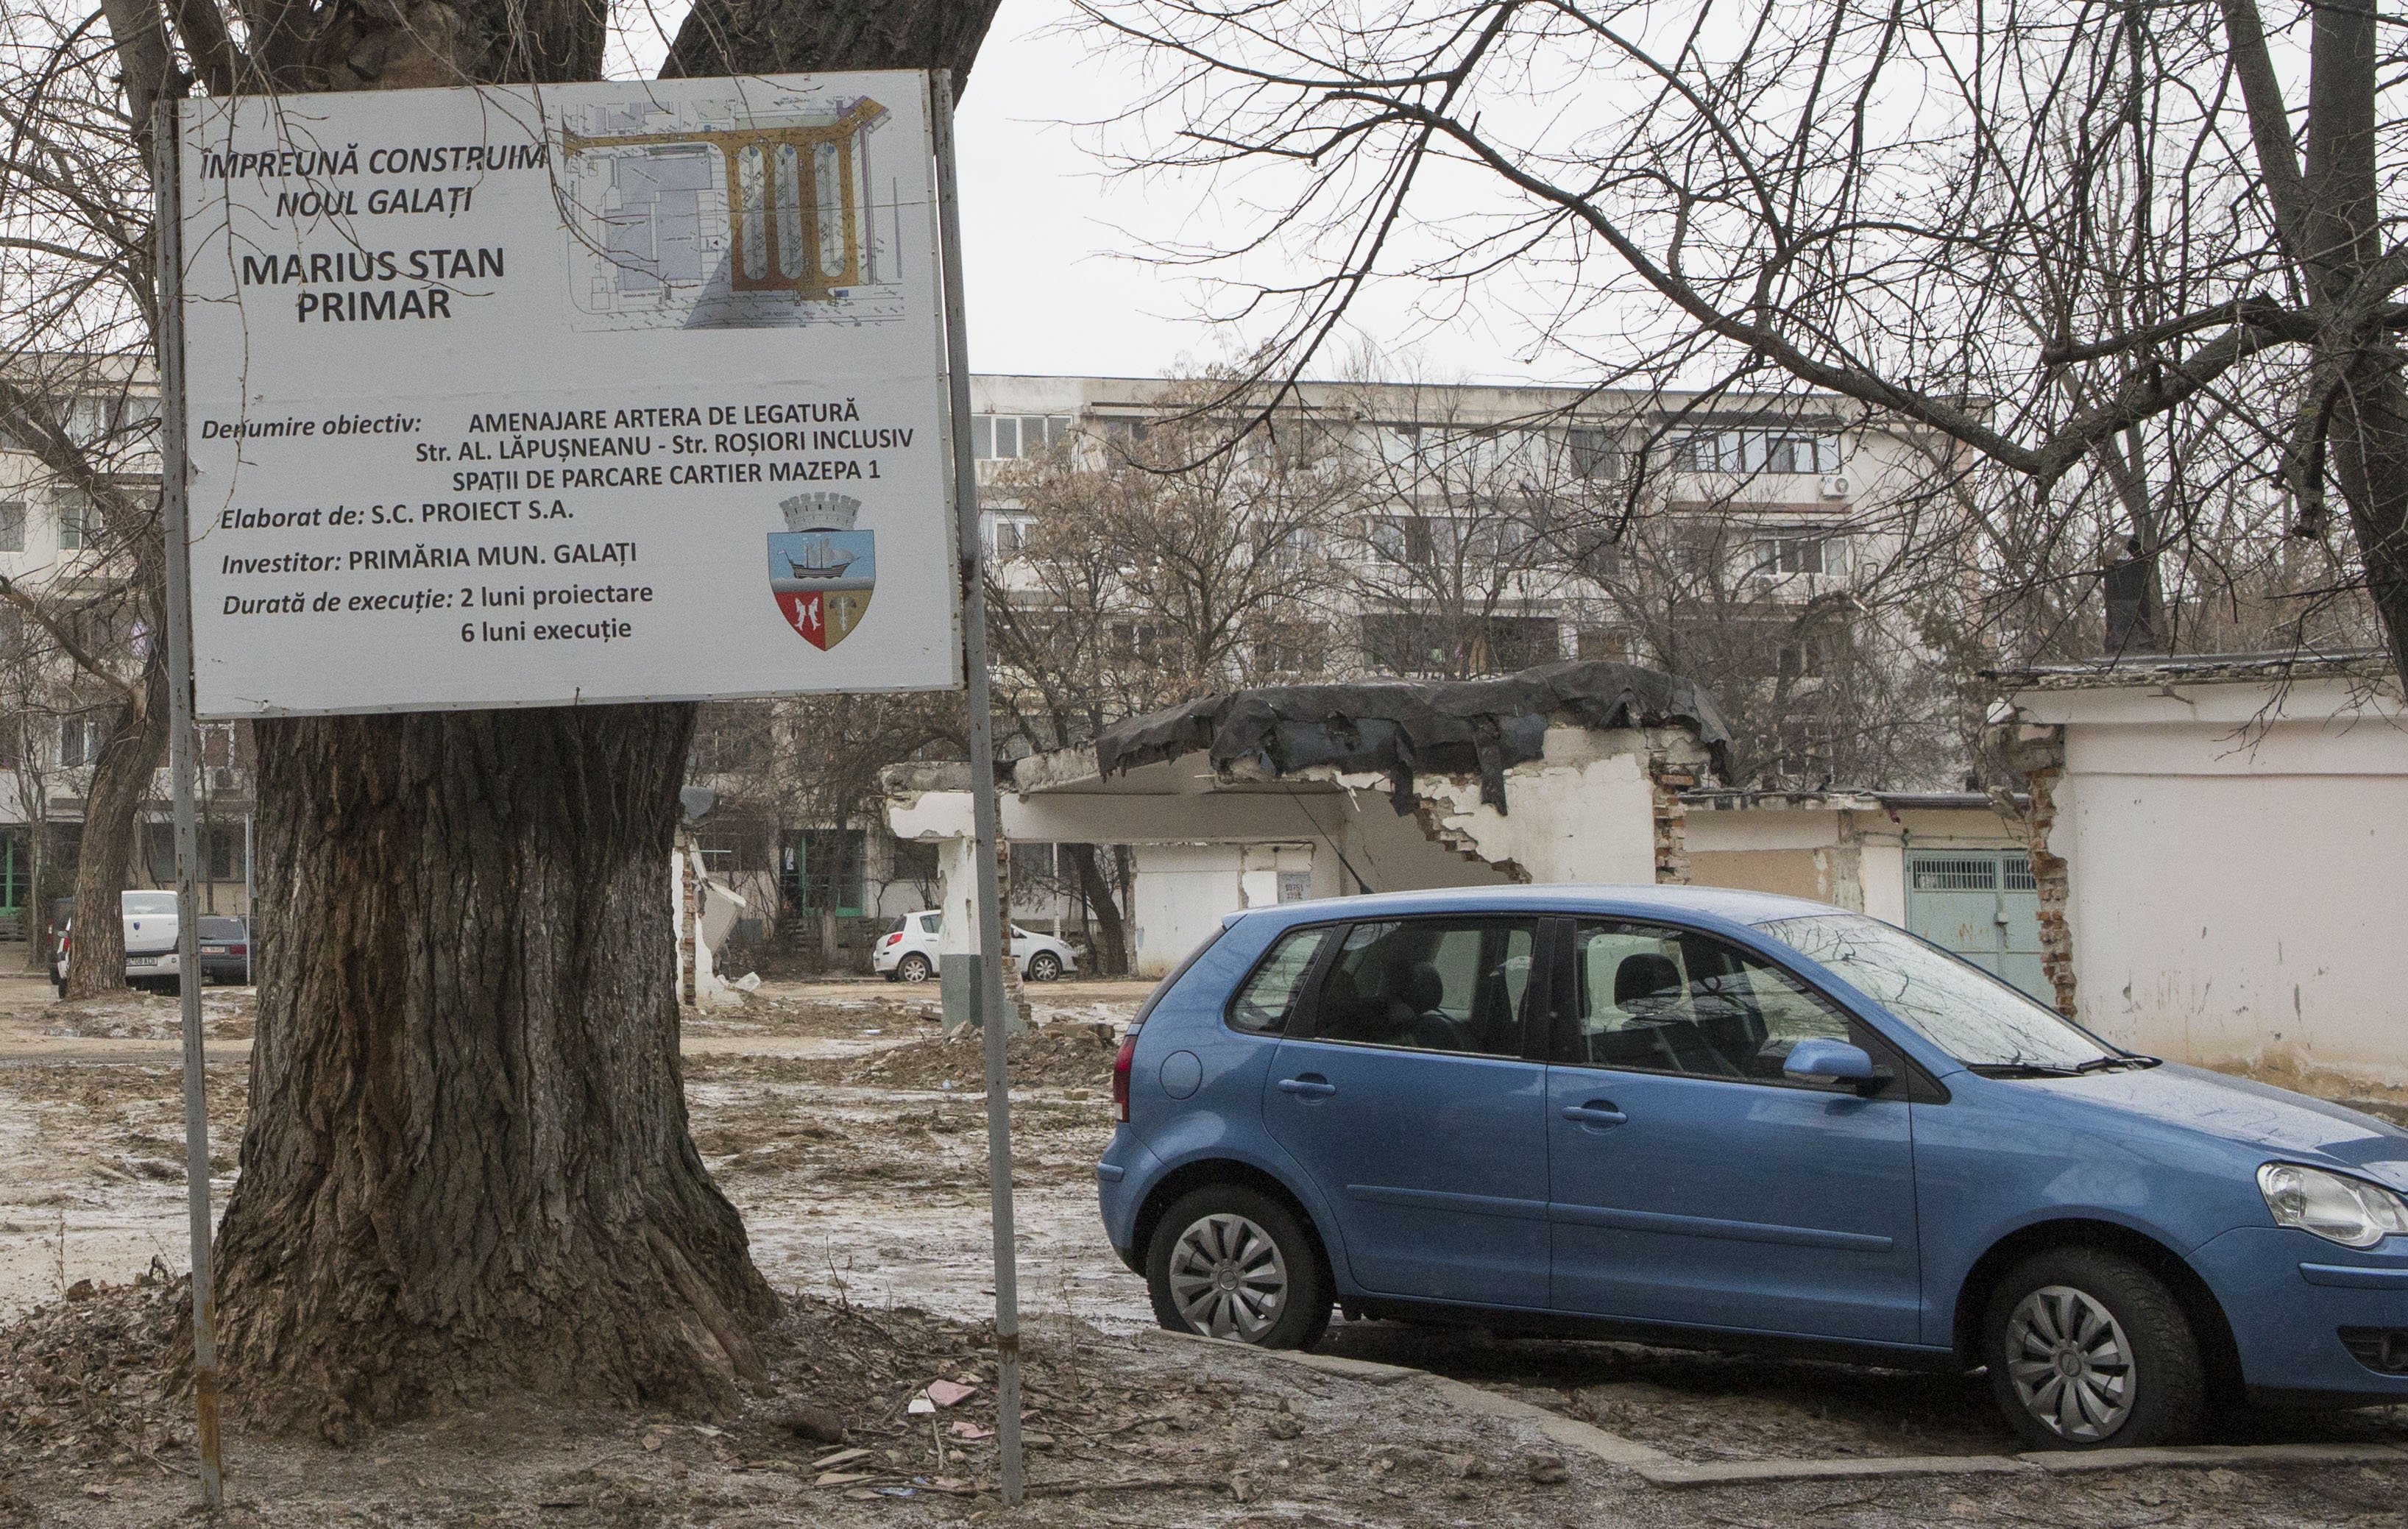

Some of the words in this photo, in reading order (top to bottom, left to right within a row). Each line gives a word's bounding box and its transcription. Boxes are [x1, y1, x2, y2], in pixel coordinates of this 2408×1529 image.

[369, 144, 547, 174] CONSTRUIM
[277, 191, 358, 218] NOUL
[368, 186, 473, 219] GALAȚI
[243, 251, 397, 285] MARIUS
[410, 248, 504, 279] STAN
[298, 289, 451, 322] PRIMAR
[202, 416, 316, 439] Denumire
[322, 413, 421, 436] obiectiv:
[469, 410, 607, 433] AMENAJARE
[614, 407, 702, 429] ARTERA
[709, 405, 737, 425] DE
[744, 397, 860, 425] LEGATURĂ
[416, 443, 451, 462] Str.
[458, 441, 492, 461] AL.
[500, 435, 651, 463] LĂPUȘNEANU
[672, 435, 707, 455] Str.
[715, 431, 805, 457] ROȘIORI
[813, 428, 913, 450] INCLUSIV
[453, 471, 518, 493] SPAȚII
[526, 469, 555, 489] DE
[562, 466, 662, 488] PARCARE
[670, 463, 762, 485] CARTIER
[769, 460, 862, 481] MAZEPA
[869, 460, 881, 479] 1
[221, 508, 322, 529] Elaborat
[328, 505, 364, 525] de:
[372, 504, 414, 525] S.C.
[422, 500, 522, 522] PROIECT
[528, 500, 573, 519] S.A.
[222, 552, 341, 575] Investitor:
[349, 543, 470, 570] PRIMĂRIA
[478, 545, 545, 566] MUN.
[553, 542, 636, 567] GALAȚI
[223, 592, 305, 615] Durată
[312, 591, 341, 612] de
[348, 588, 453, 614] execuție:
[461, 588, 474, 608] 2
[481, 586, 525, 607] luni
[533, 584, 653, 610] proiectare
[461, 622, 475, 642] 6
[482, 620, 525, 642] luni
[534, 617, 631, 643] execuție
